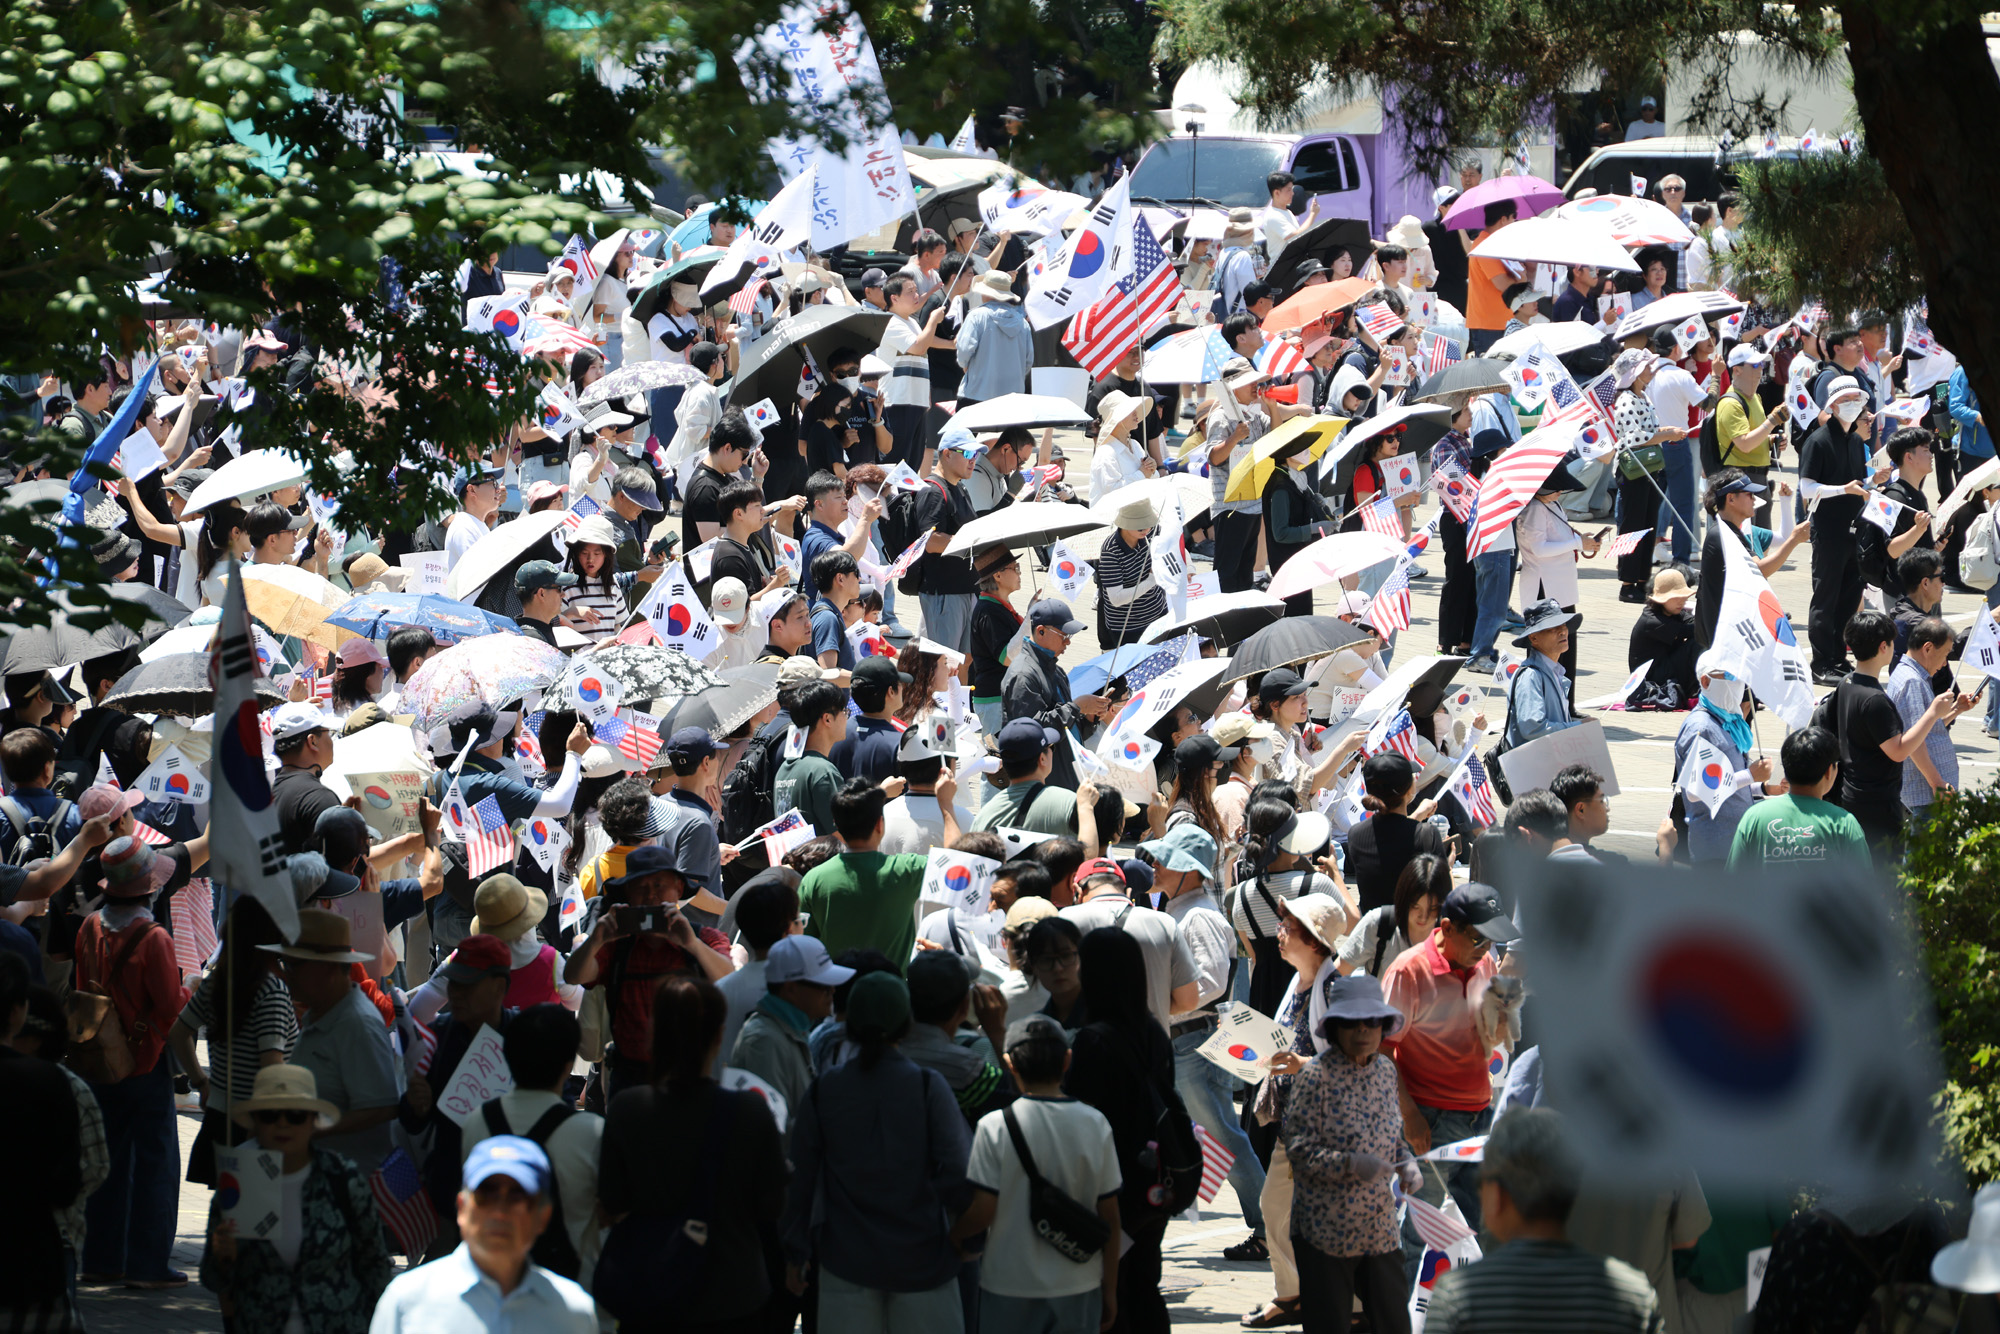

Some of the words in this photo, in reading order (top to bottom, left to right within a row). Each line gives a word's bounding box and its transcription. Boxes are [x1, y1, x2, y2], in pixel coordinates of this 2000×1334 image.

[761, 320, 821, 361] maruman
[424, 562, 442, 572] 부정선거
[634, 714, 658, 726] 부정선거
[1036, 1218, 1092, 1262] adidas
